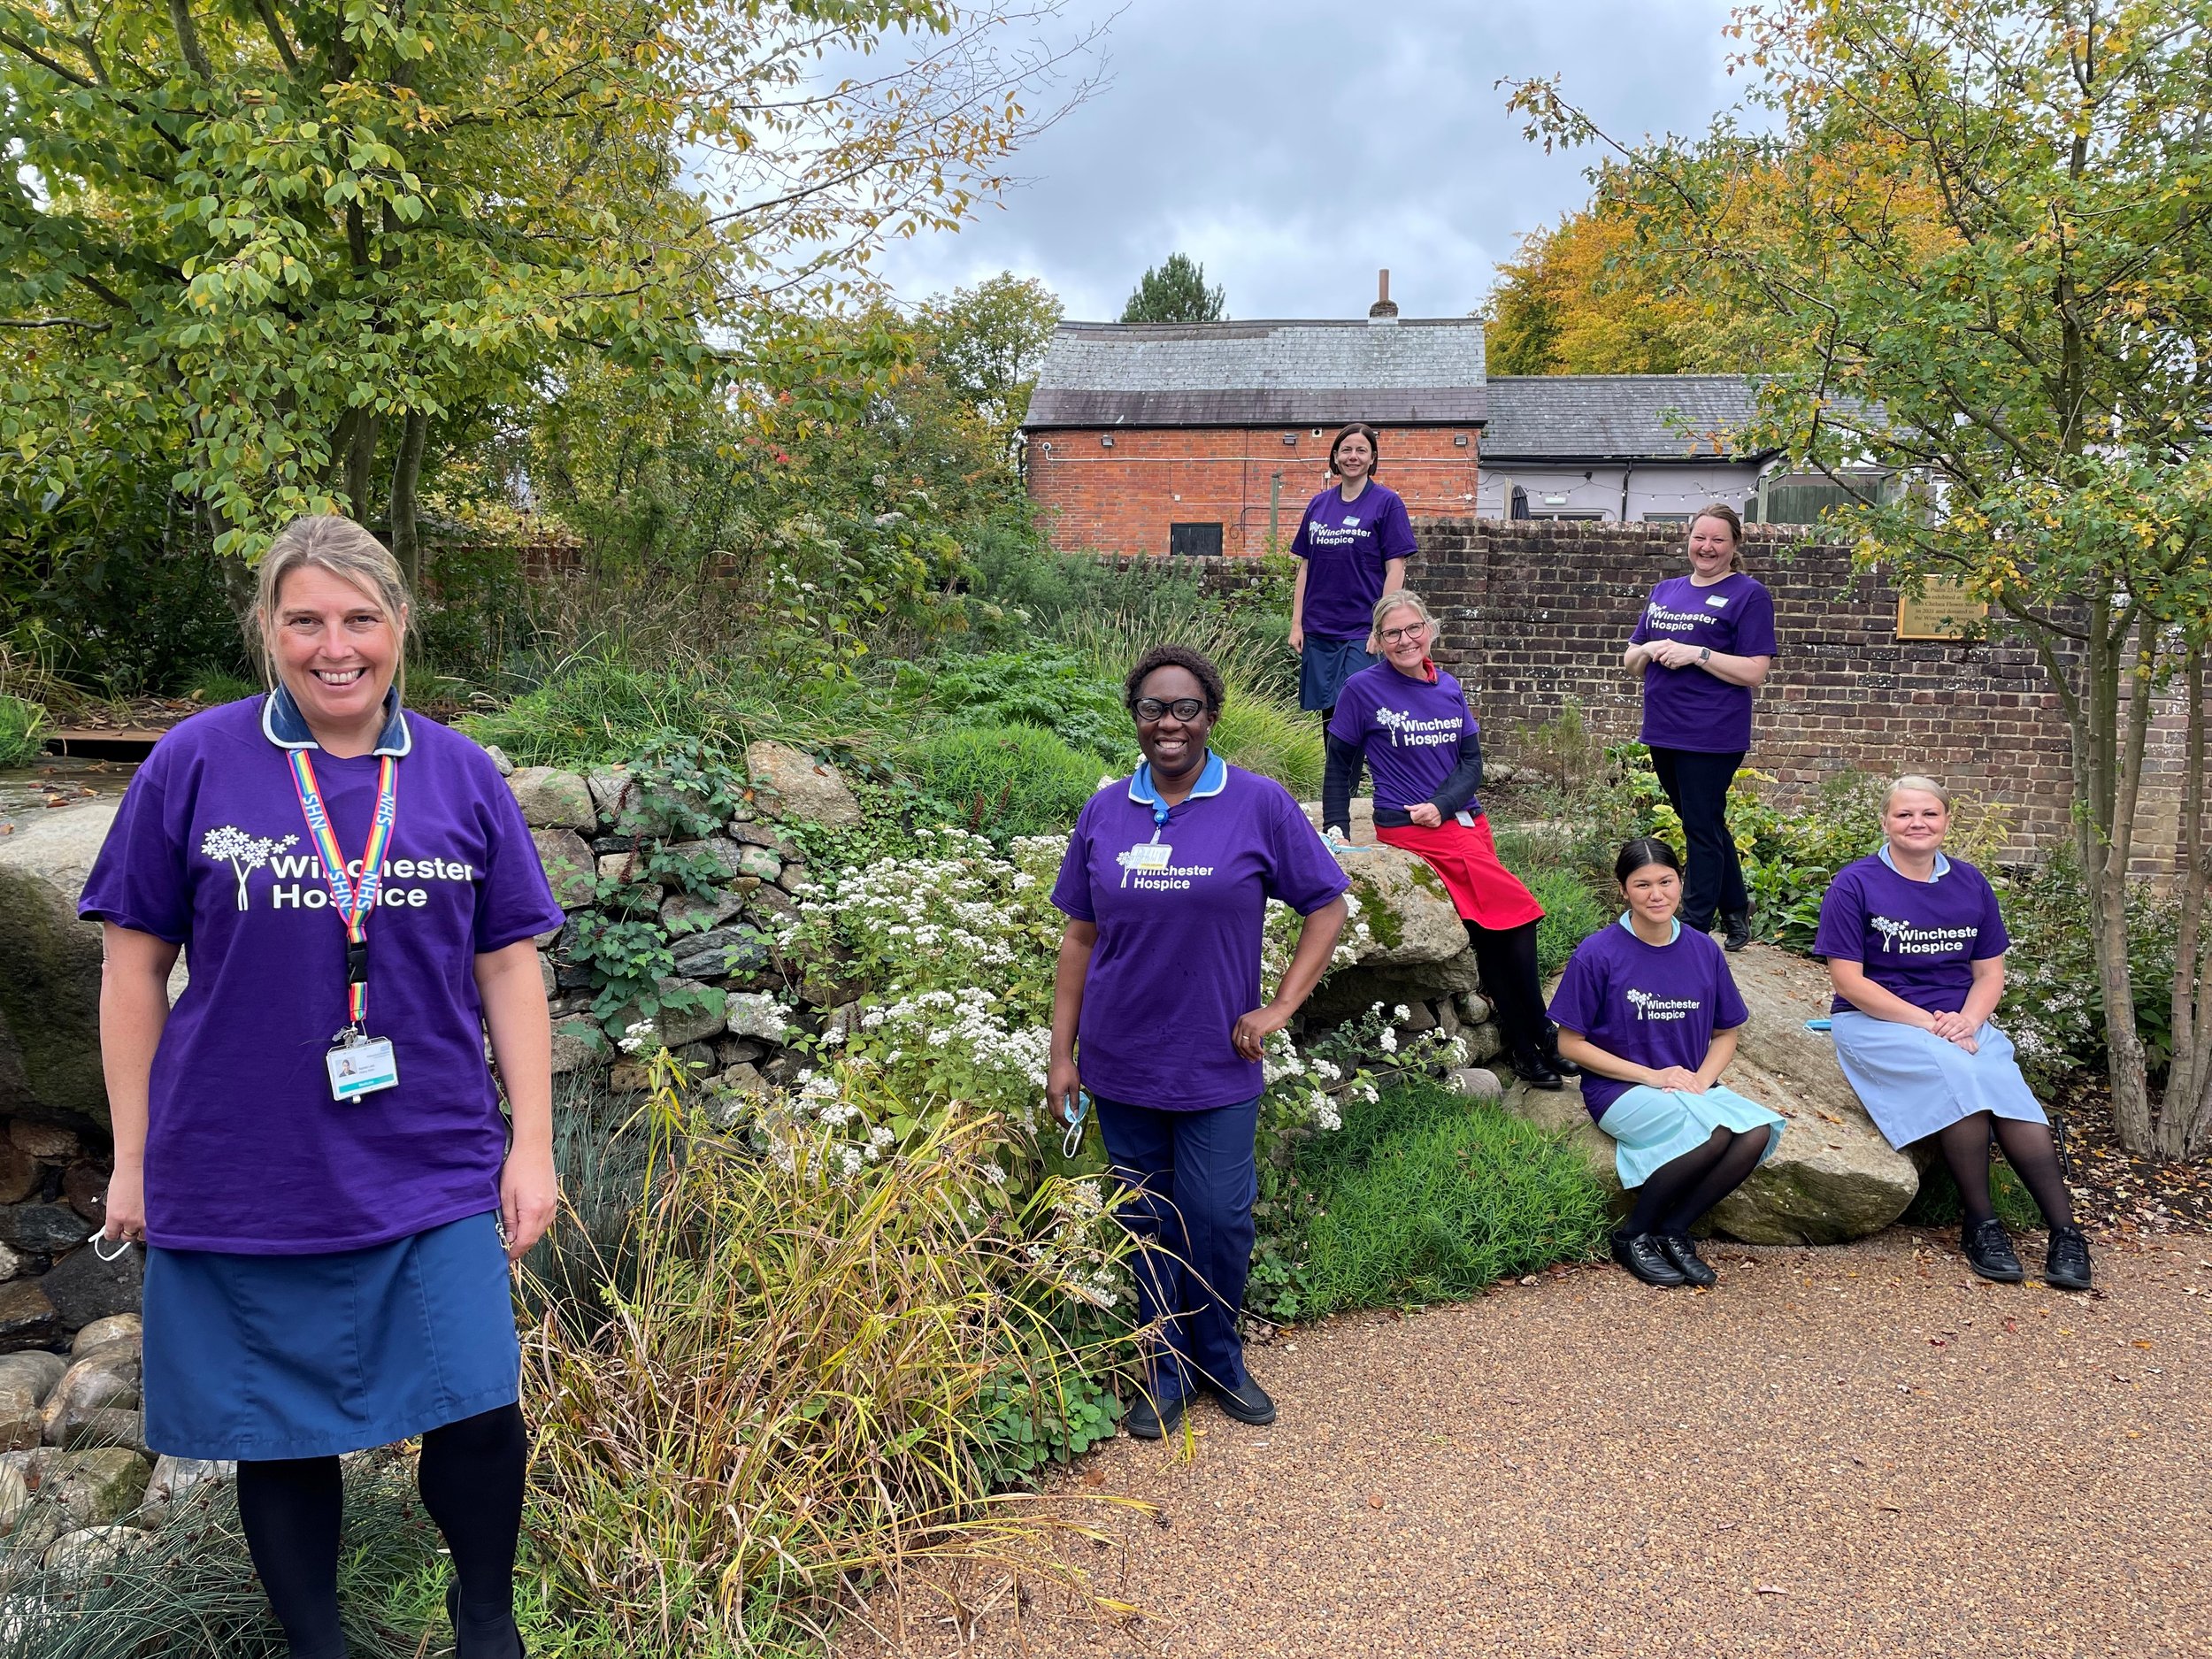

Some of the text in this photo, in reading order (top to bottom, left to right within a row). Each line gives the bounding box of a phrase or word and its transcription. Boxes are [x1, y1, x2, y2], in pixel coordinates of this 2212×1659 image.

[1318, 528, 1371, 537] Winchester
[1317, 536, 1355, 546] Hospice
[1651, 619, 1694, 632] Hospice
[1654, 611, 1717, 625] Winchester
[1401, 717, 1463, 732] Winchest
[1403, 732, 1457, 747] Hospice
[303, 792, 328, 829] NHS
[377, 792, 395, 826] NHS
[270, 856, 472, 881] Wicester
[329, 871, 354, 909] NHS
[356, 872, 380, 910] NHS
[1133, 877, 1191, 892] Hospice
[1898, 926, 1978, 941] Wincheste
[1899, 941, 1963, 954] Hospice
[1646, 1000, 1700, 1010] Winchester
[1647, 1010, 1686, 1021] Hospice
